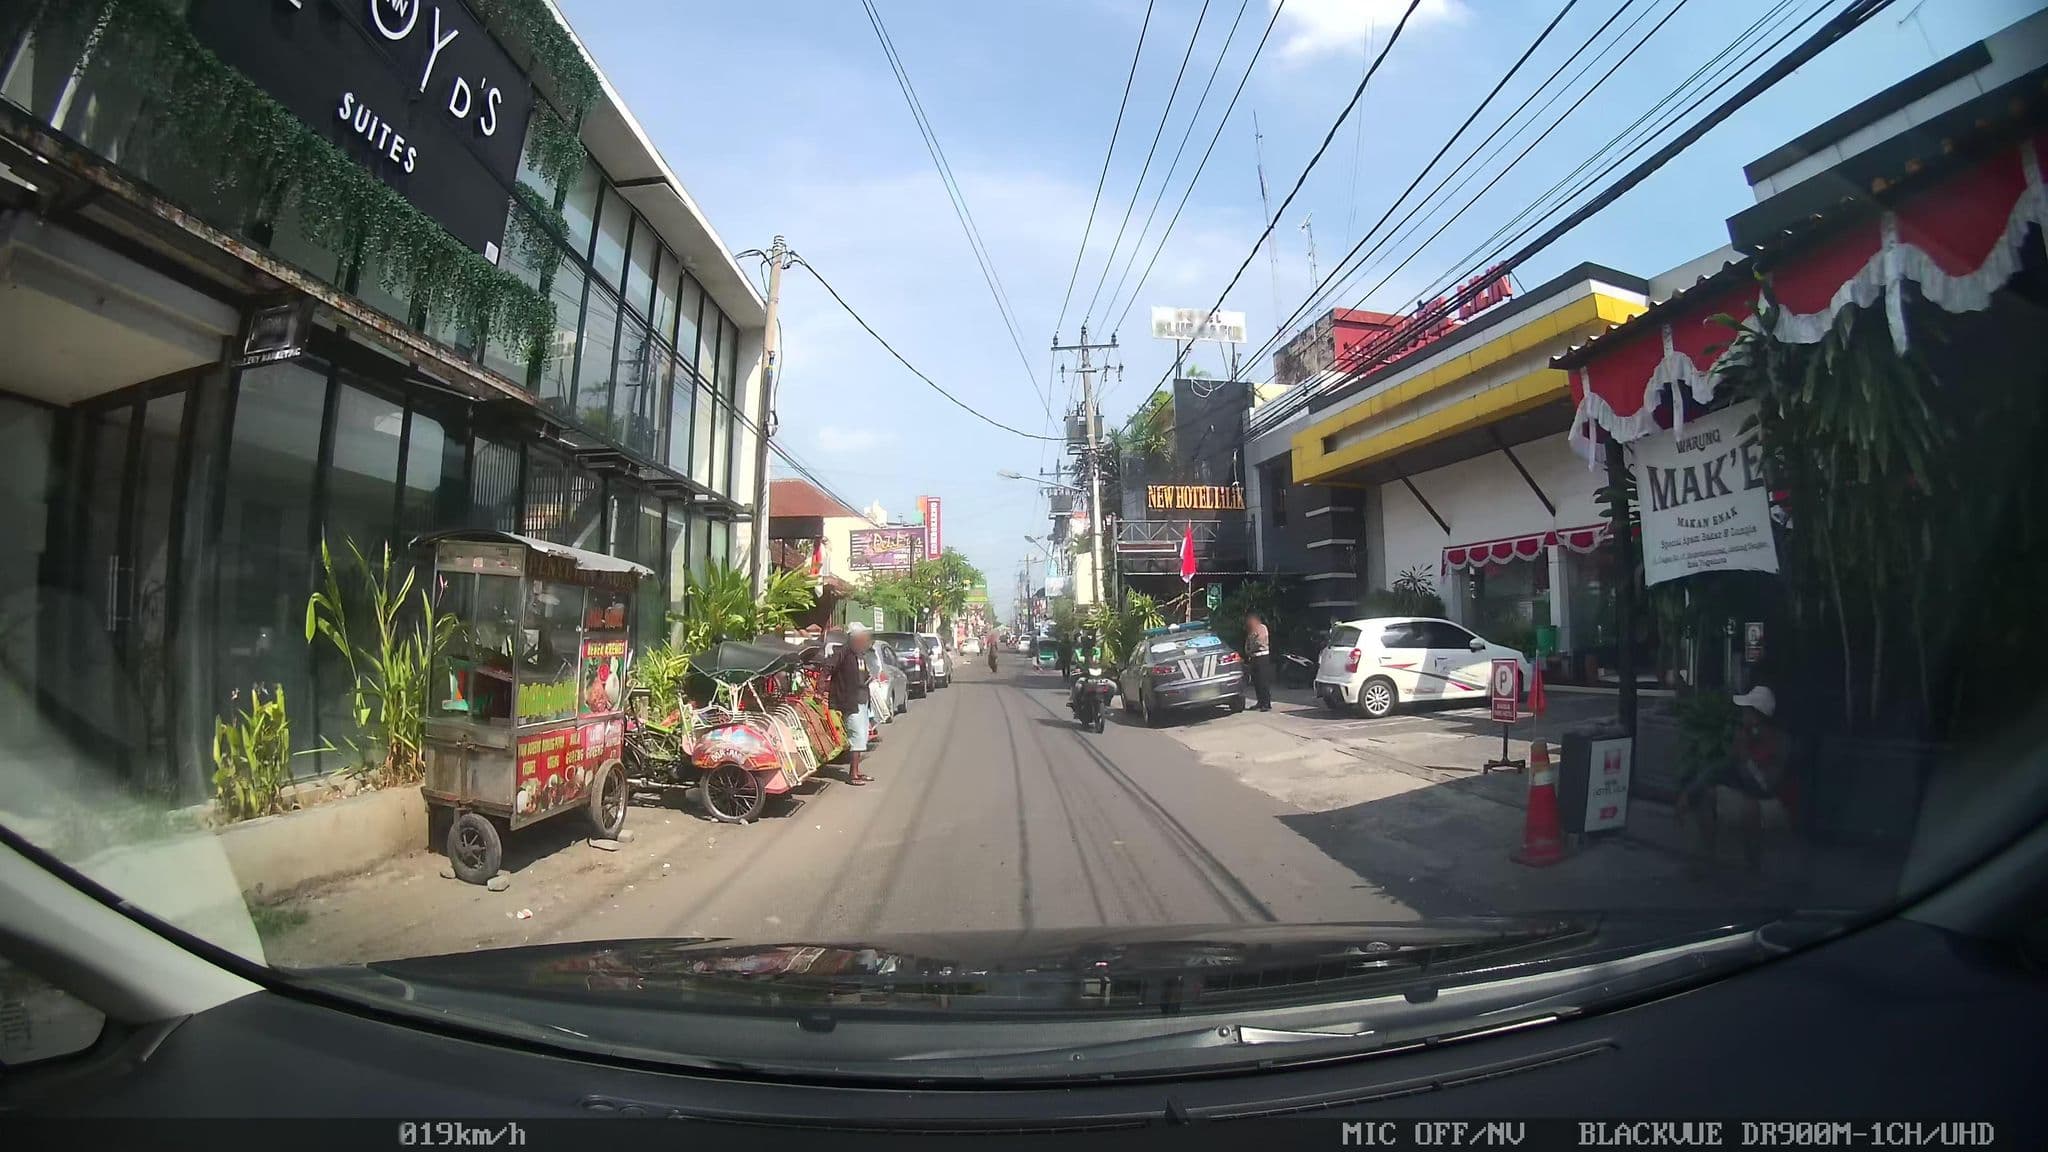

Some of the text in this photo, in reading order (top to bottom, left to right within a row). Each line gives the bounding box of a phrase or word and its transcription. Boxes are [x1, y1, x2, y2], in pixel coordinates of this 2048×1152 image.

[1676, 429, 1721, 454] WARUNG
[1647, 440, 1765, 512] MAK'E
[1148, 485, 1174, 508] NEW
[1175, 485, 1214, 509] HOTEL
[1677, 506, 1738, 529] MAKAN ENAK
[1500, 670, 1507, 691] P
